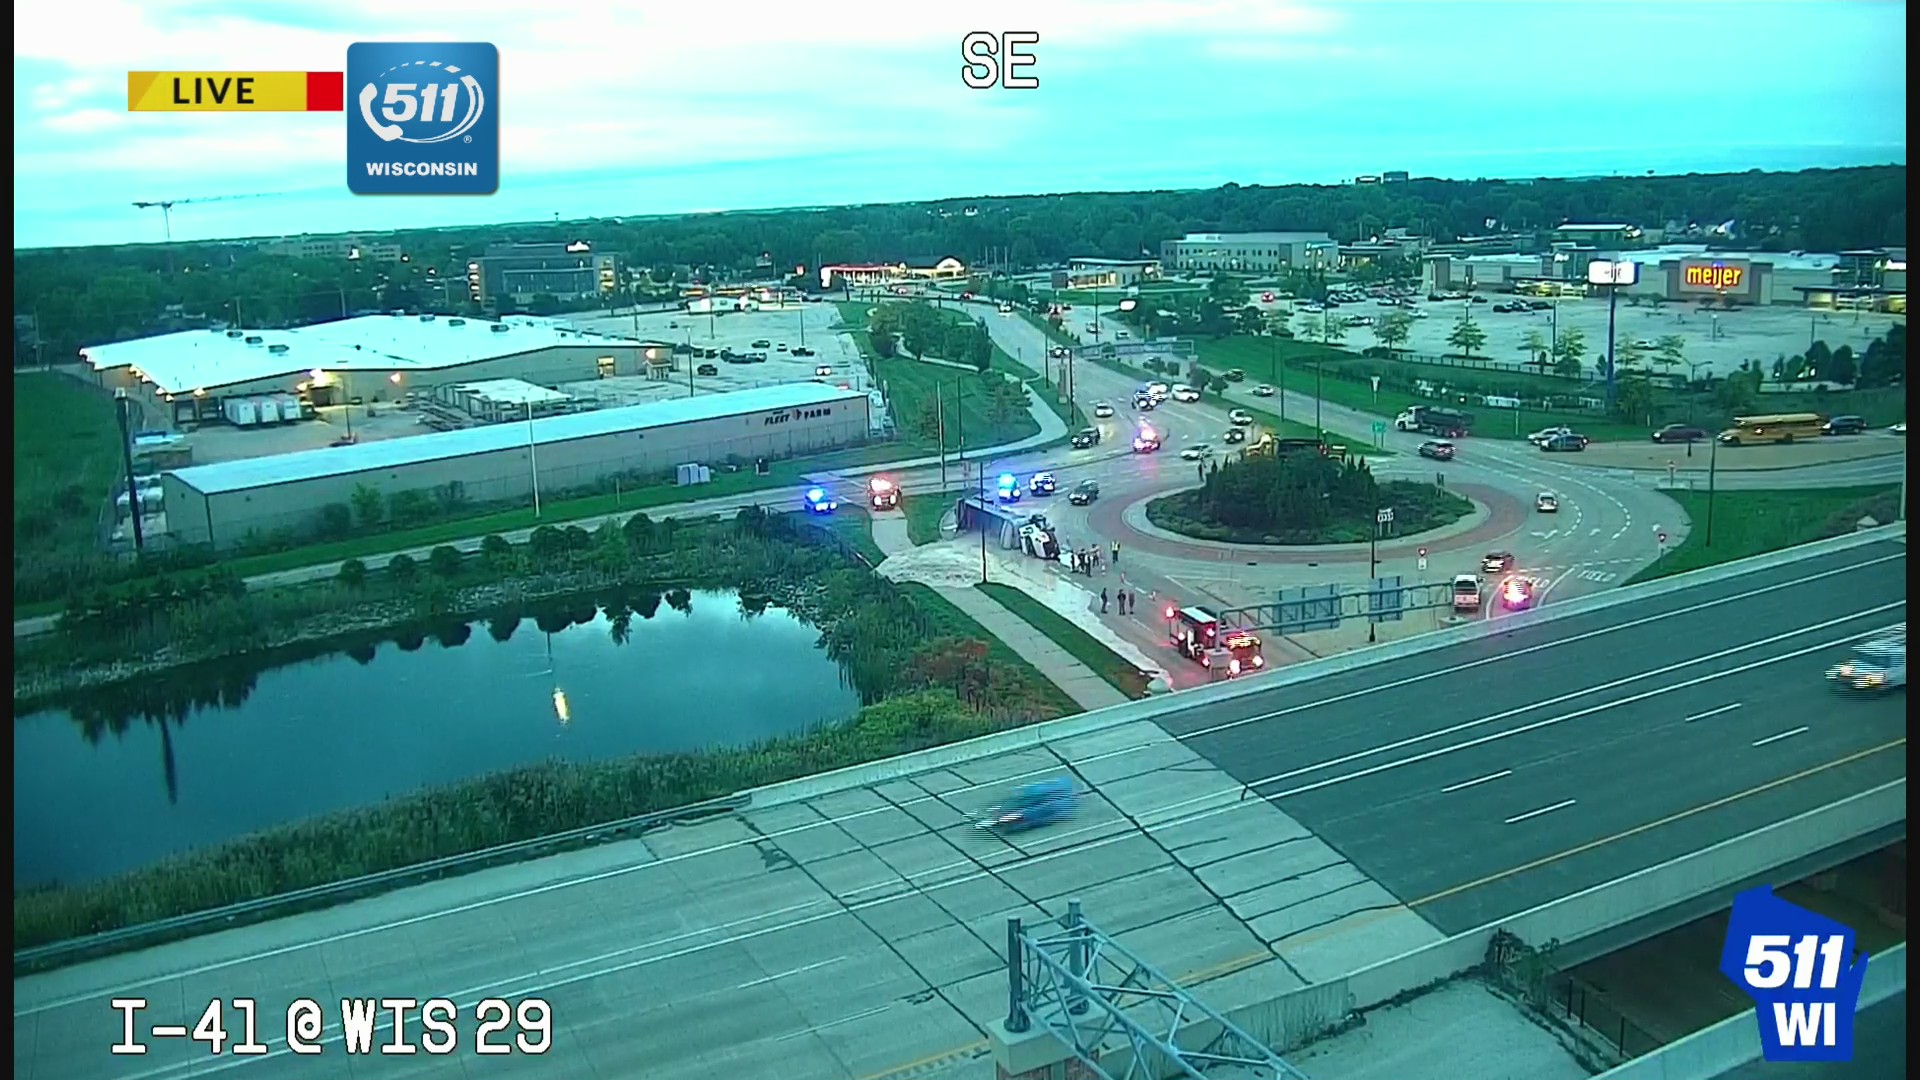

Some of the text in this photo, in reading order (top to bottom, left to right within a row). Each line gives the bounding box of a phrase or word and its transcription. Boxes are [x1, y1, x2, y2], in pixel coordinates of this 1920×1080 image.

[1687, 263, 1742, 289] meijer
[764, 407, 831, 427] FLEET FARM
